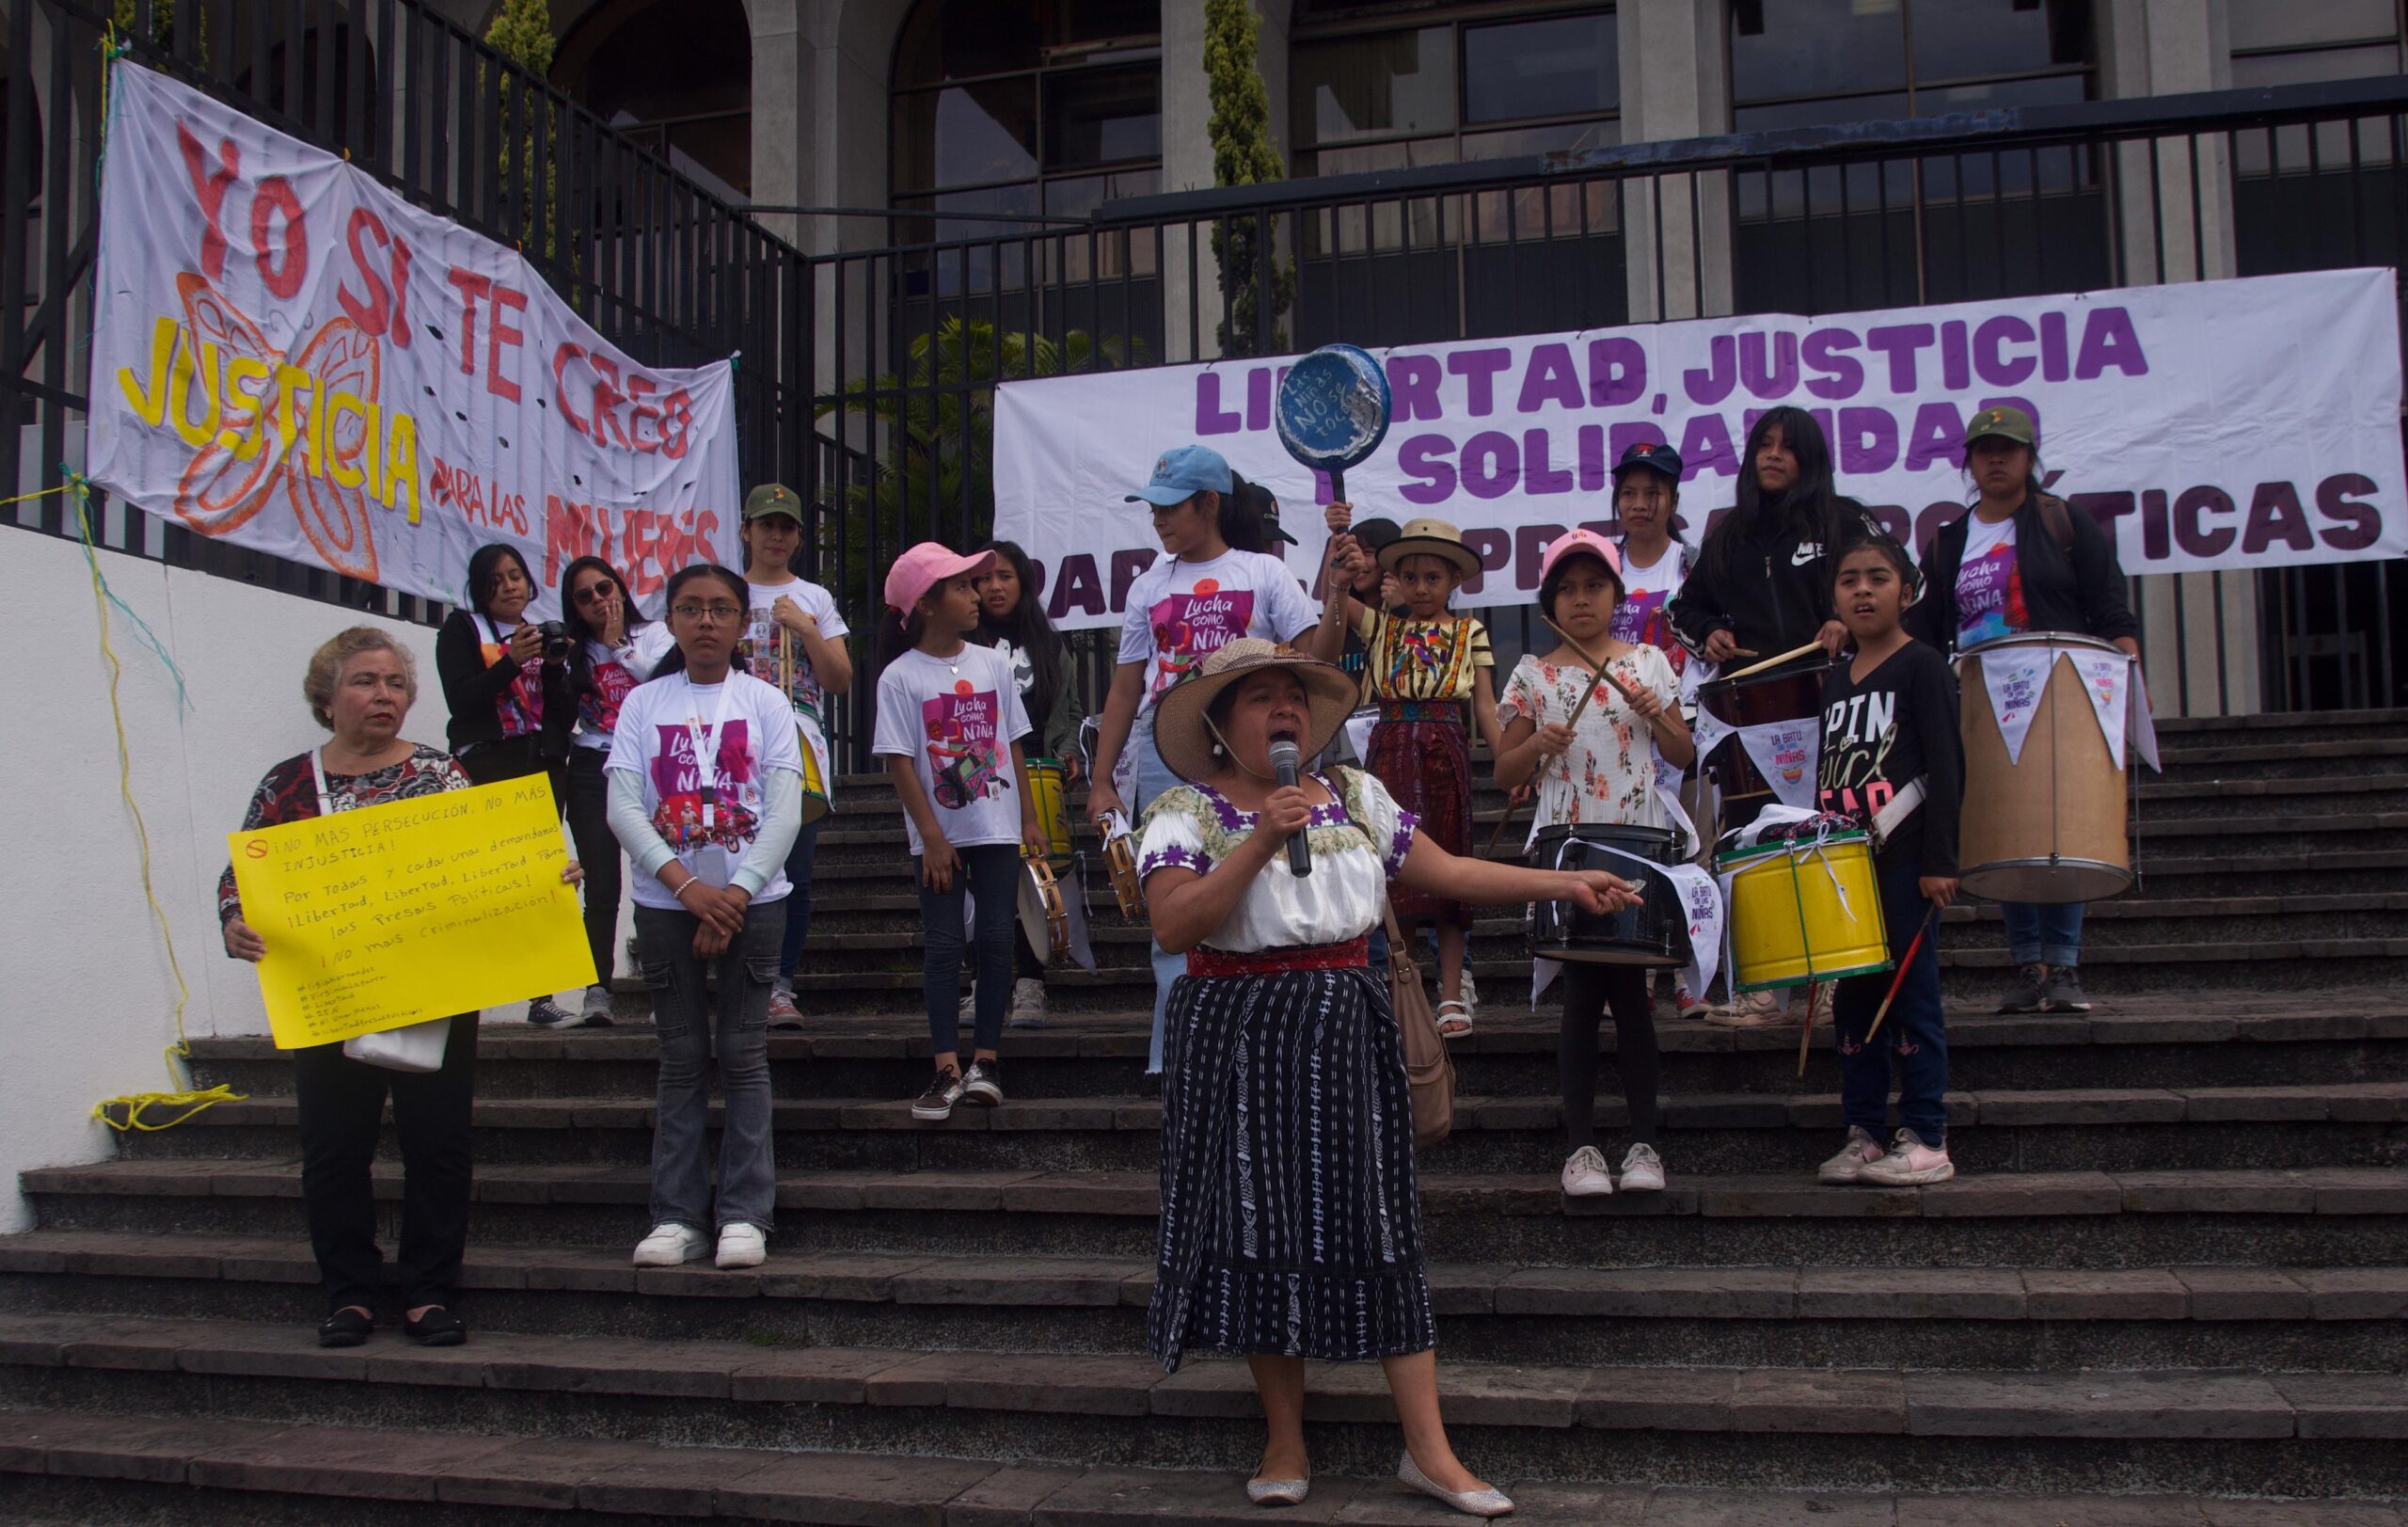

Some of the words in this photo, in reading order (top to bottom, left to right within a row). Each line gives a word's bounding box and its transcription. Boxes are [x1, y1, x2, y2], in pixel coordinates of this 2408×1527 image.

[176, 114, 308, 299] YO
[339, 208, 414, 349] SI
[447, 266, 529, 406] TE
[553, 342, 695, 461] CREO
[1684, 307, 2148, 406] JUSTICIA
[118, 317, 421, 527] JUSTICIA
[1293, 399, 1327, 431] NO
[430, 456, 487, 528] PARA
[491, 481, 529, 536] LAS
[1958, 575, 1992, 596] como
[1183, 595, 1233, 619] Lucha
[1192, 615, 1224, 628] como
[2012, 680, 2030, 692] BATU
[954, 696, 987, 718] Lucha
[2004, 696, 2031, 710] NIÑAS
[960, 712, 985, 724] como
[1771, 735, 1781, 746] LA
[1782, 730, 1802, 744] BATU
[1775, 750, 1806, 765] NIÑAS
[485, 795, 502, 812] NO
[514, 785, 547, 804] MÁS
[406, 857, 444, 874] cada
[452, 848, 480, 863] una
[1691, 905, 1714, 920] NIÑAS
[330, 921, 356, 940] las
